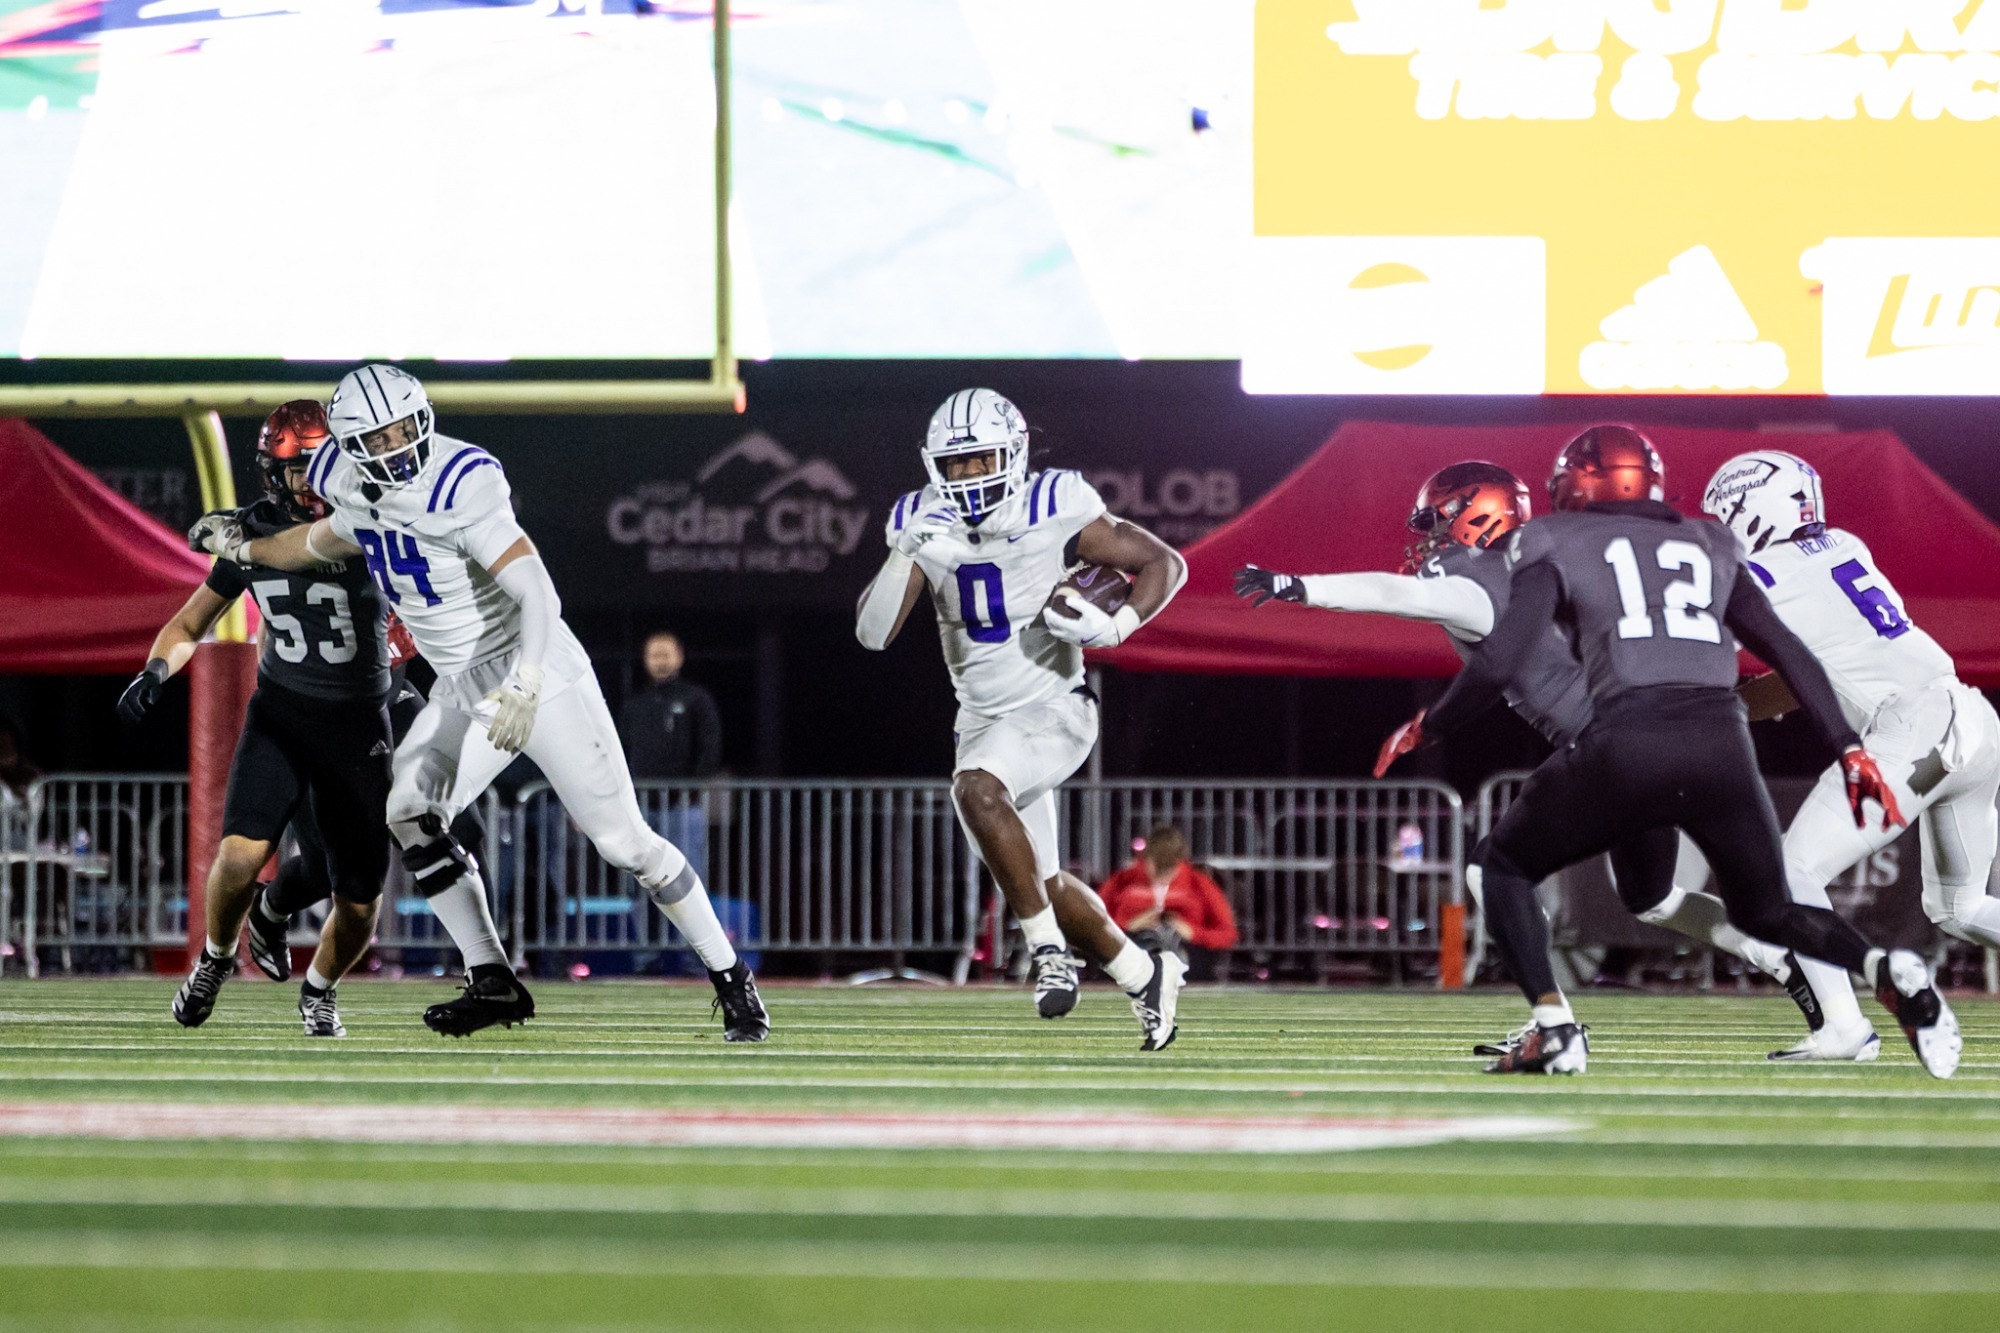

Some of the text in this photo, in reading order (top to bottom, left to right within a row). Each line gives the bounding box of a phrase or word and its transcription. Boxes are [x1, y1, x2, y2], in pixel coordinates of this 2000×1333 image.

[1086, 467, 1239, 515] OLOB
[1713, 477, 1769, 507] Arkansas
[1716, 461, 1762, 488] Central
[607, 493, 871, 556] Cedar City
[353, 528, 442, 607] 84
[955, 562, 1011, 644] 0
[1603, 536, 1722, 645] 12
[251, 578, 358, 665] 53
